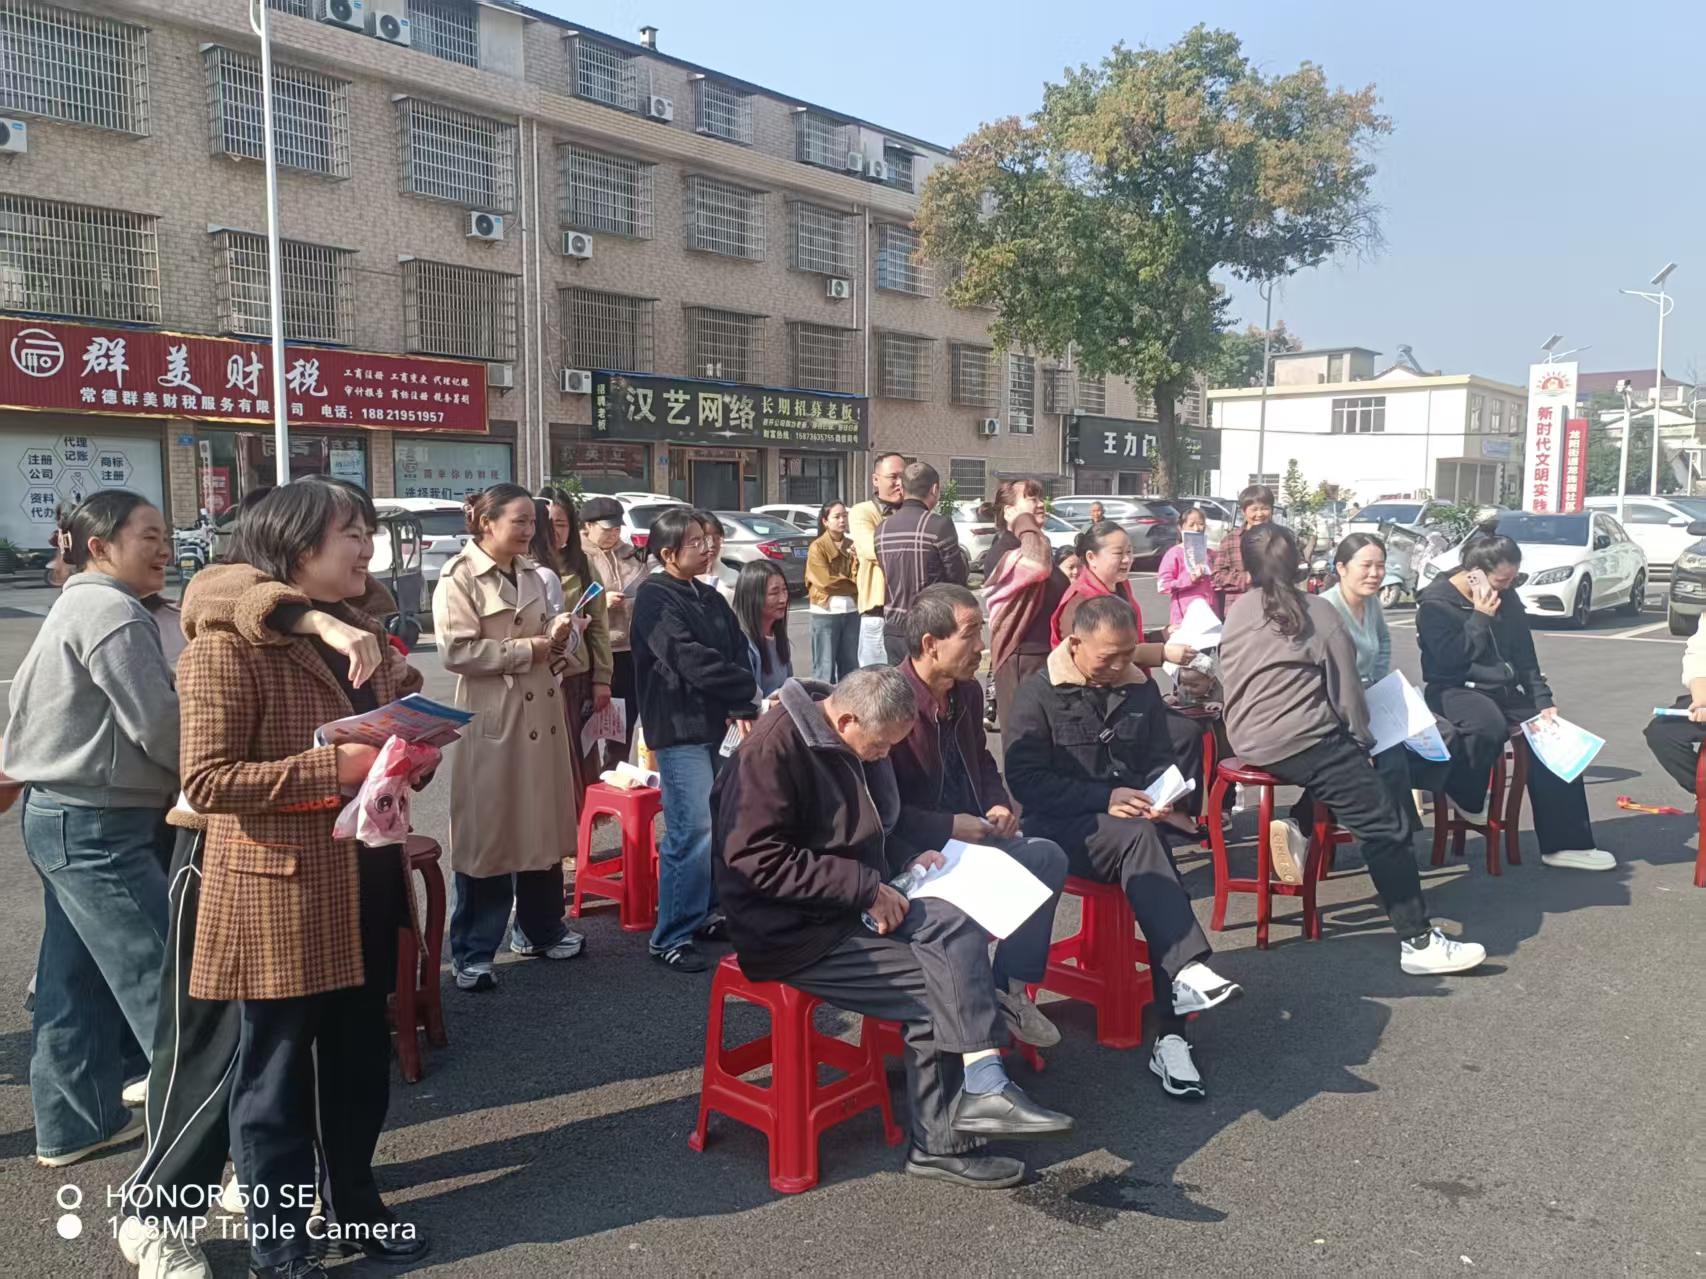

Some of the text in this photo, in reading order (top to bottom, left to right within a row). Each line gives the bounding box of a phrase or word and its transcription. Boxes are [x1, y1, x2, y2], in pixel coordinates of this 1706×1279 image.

[80, 336, 328, 397] 群美财税
[344, 367, 384, 381] 工商注册
[344, 384, 384, 399] 审计报告
[390, 388, 428, 401] 商标注册
[80, 386, 304, 417] 常德群美财税服务有限司
[361, 407, 445, 423] 18821951957
[626, 386, 756, 430] 汉艺网络
[64, 436, 88, 448] 代理
[1103, 431, 1157, 458] 王力门
[28, 454, 53, 465] 注册
[65, 450, 89, 461] 记账
[1532, 405, 1553, 513] 新时代文明实践
[100, 457, 124, 468] 商标
[29, 469, 53, 480] 公司
[102, 471, 124, 481] 注册
[30, 493, 55, 504] 资料
[31, 507, 55, 518] 代办
